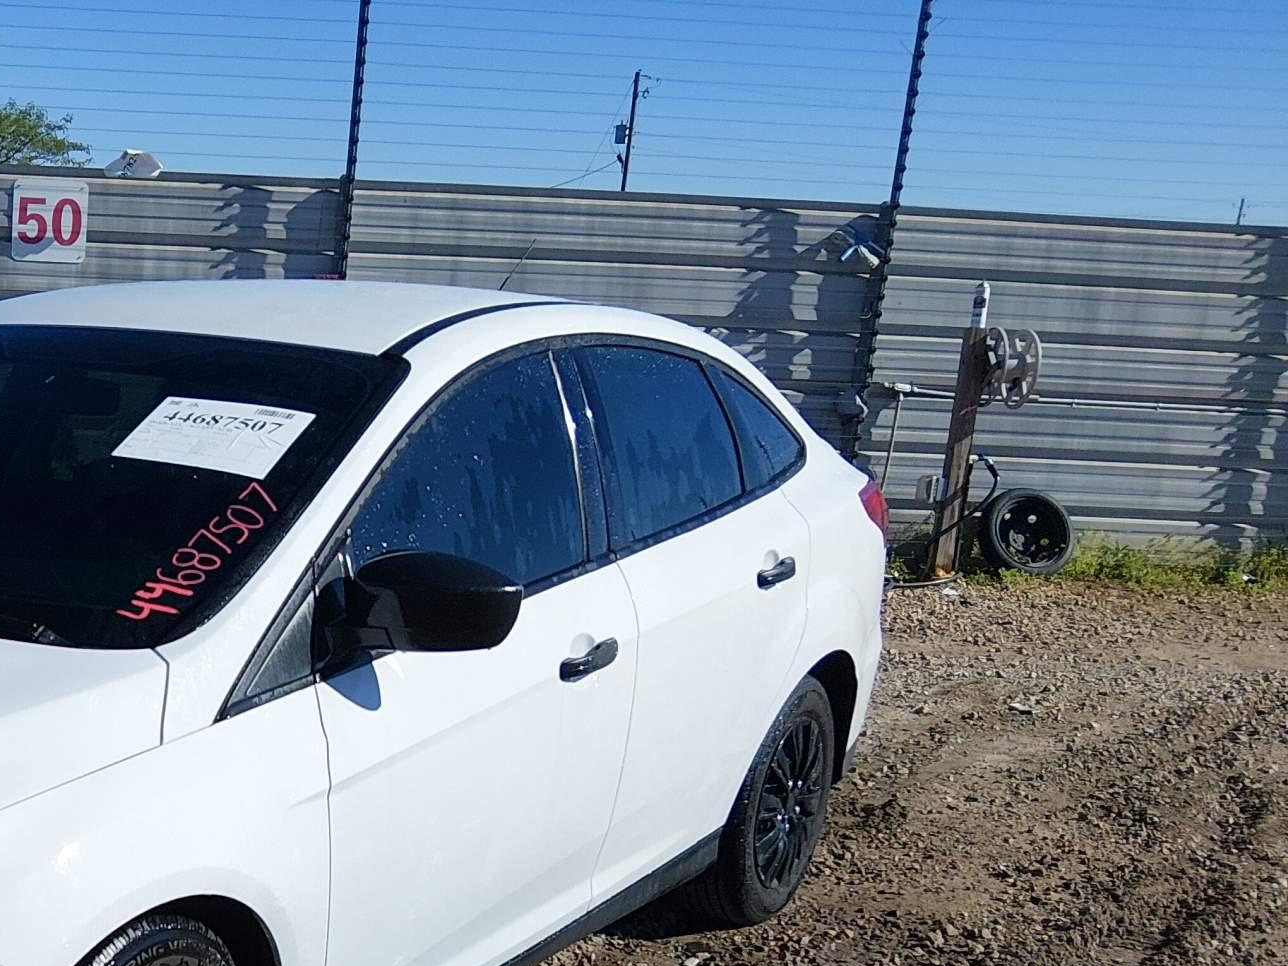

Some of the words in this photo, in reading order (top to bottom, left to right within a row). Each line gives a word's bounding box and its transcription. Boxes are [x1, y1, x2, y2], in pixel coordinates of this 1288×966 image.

[17, 197, 82, 246] 50
[163, 410, 284, 435] 44687507
[116, 481, 278, 620] 44687507
